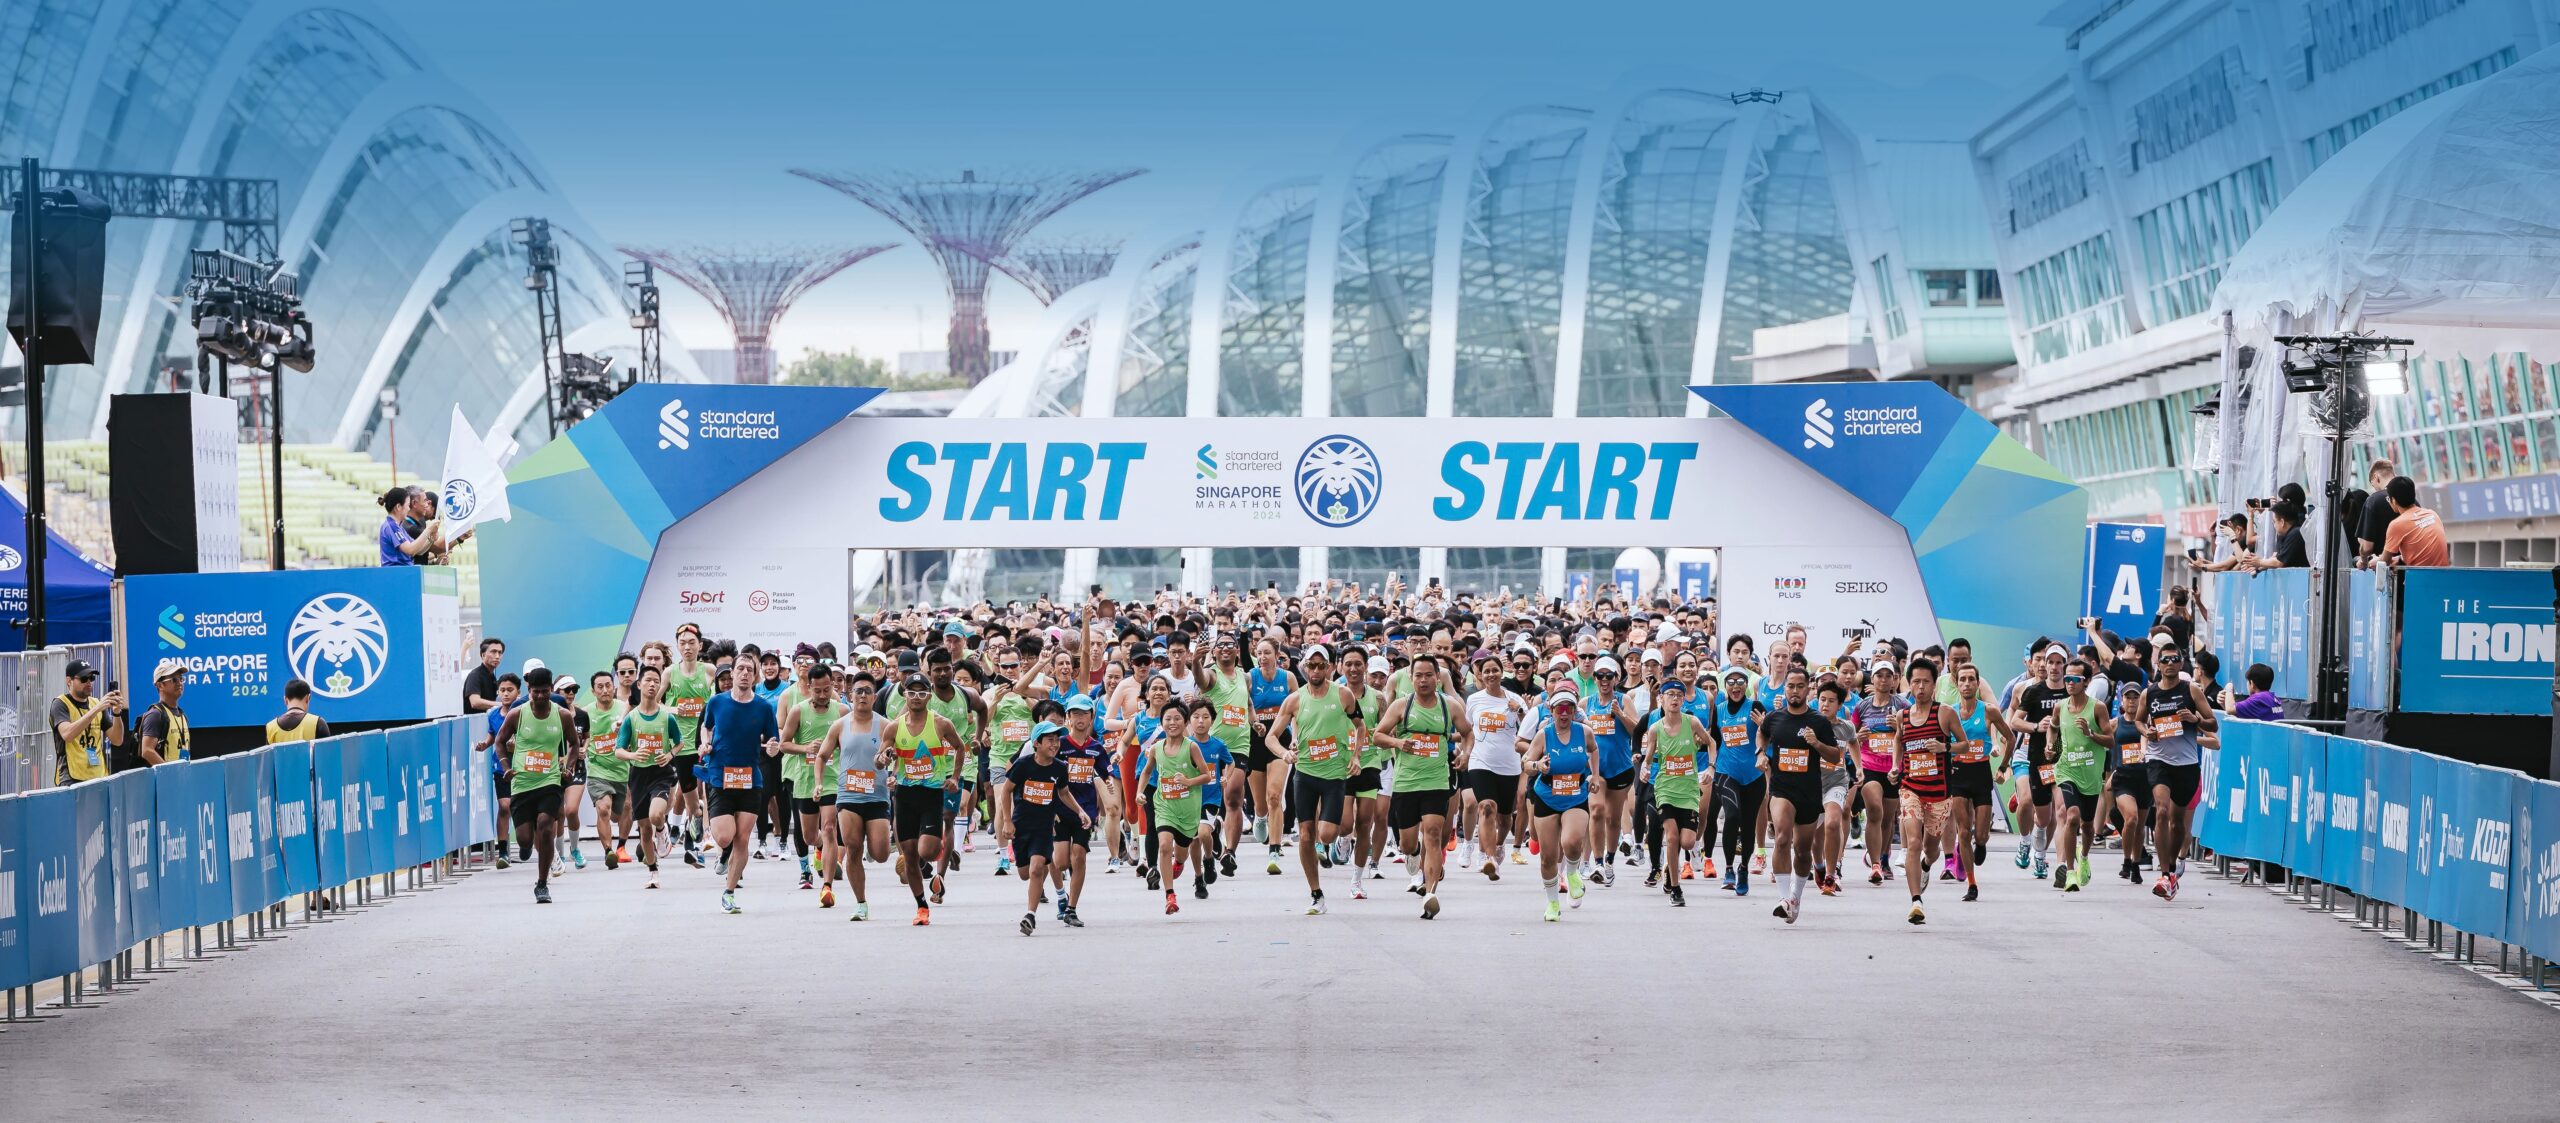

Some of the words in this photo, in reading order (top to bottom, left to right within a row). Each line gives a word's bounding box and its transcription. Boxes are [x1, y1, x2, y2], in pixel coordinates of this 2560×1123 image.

[700, 410, 774, 424] standard
[1844, 406, 1917, 421] standard
[700, 424, 778, 439] chartered
[1844, 420, 1921, 435] chartered
[1225, 451, 1279, 460] standard
[1225, 461, 1282, 471] chartered
[879, 441, 1147, 522] START
[1433, 441, 1699, 521] START
[1196, 486, 1282, 498] SINGAPORE
[1195, 500, 1281, 509] MARATHON
[1253, 511, 1281, 519] 2024
[1835, 582, 1888, 593] SEIKO
[2106, 564, 2144, 615] A
[680, 591, 725, 606] Sport
[752, 597, 767, 606] SG
[2443, 600, 2480, 614] THE
[195, 610, 262, 625] standard
[195, 623, 267, 638] chartered
[1764, 621, 1784, 635] tcs
[232, 685, 268, 697] 2024
[38, 855, 67, 917] Coached
